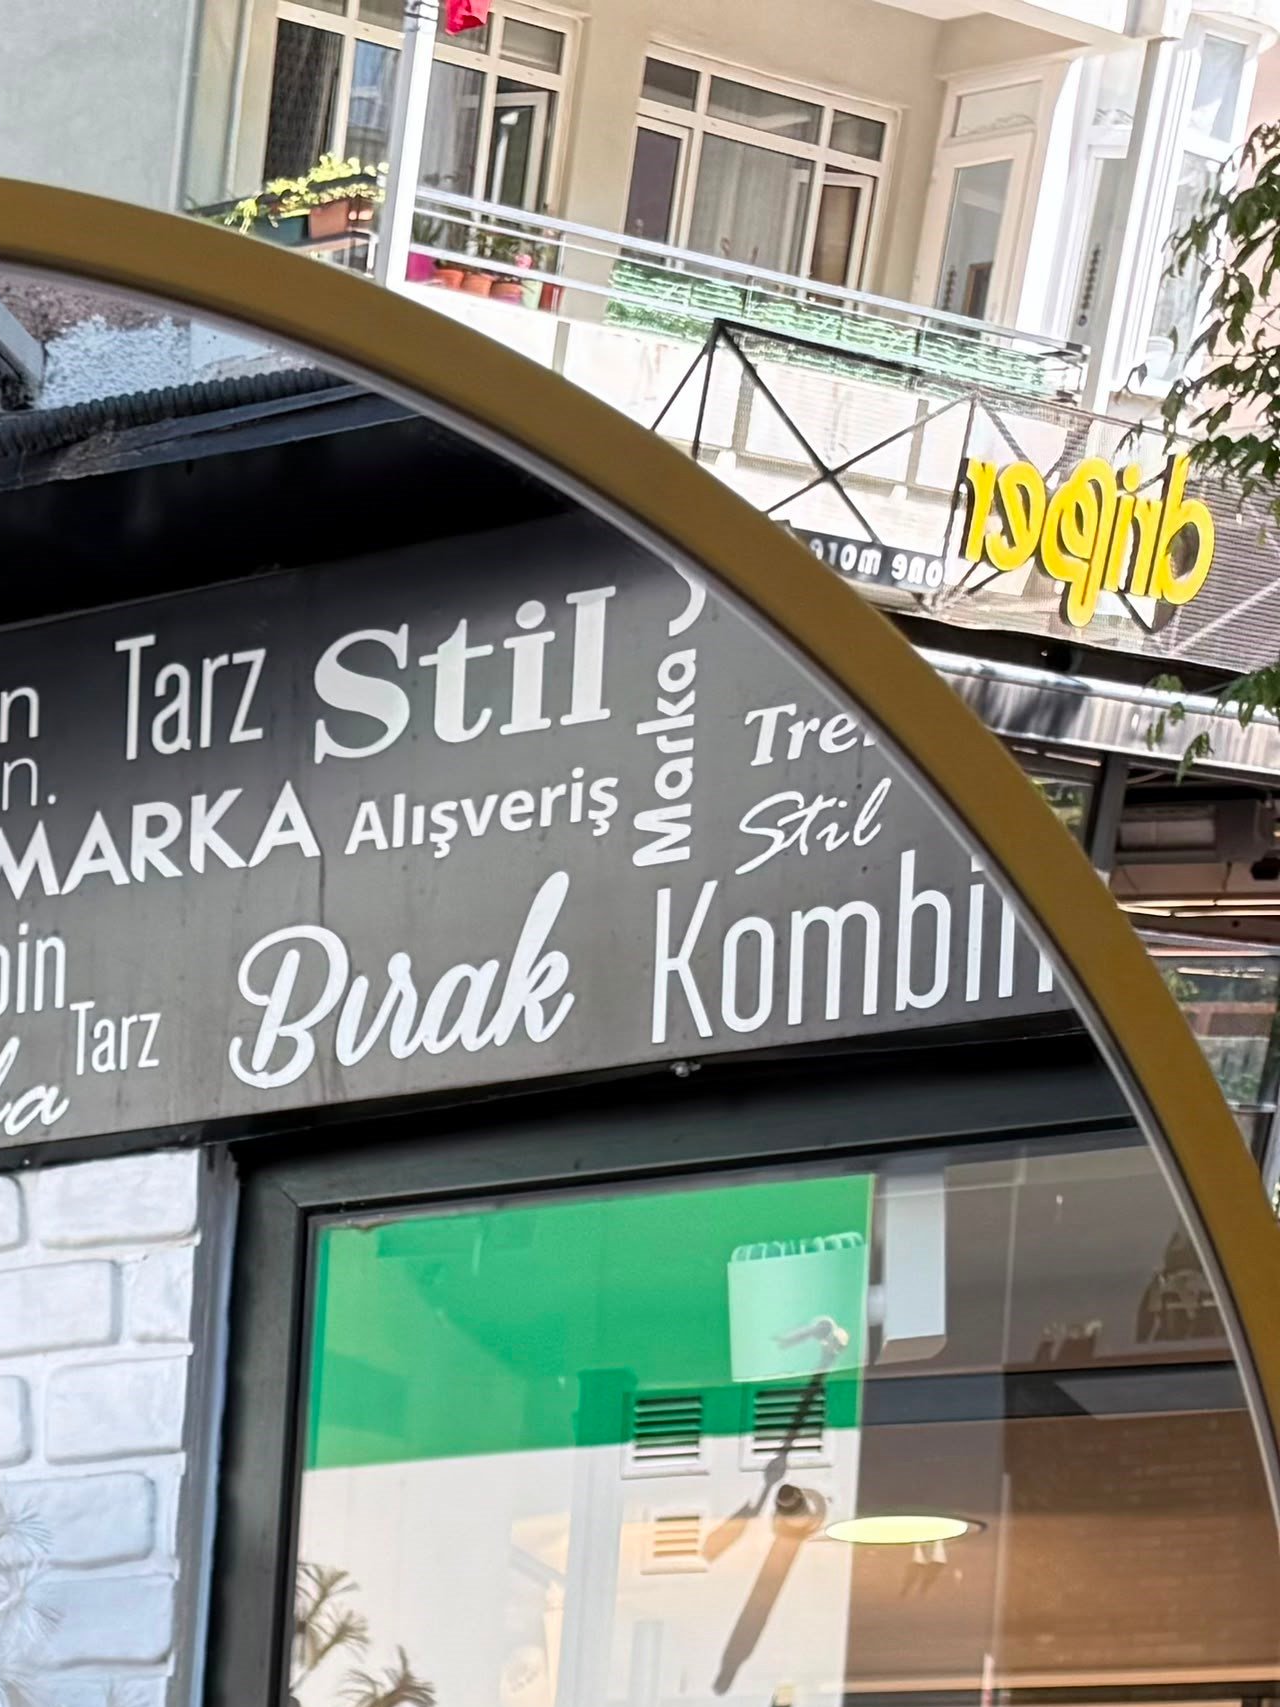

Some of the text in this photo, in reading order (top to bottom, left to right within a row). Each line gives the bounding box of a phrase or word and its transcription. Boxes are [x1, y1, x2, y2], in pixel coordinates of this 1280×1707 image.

[115, 633, 267, 760] Tarz
[315, 586, 615, 763] Stil
[344, 767, 619, 859] Alışveriş
[632, 649, 697, 867] Marka
[735, 778, 892, 875] Stil
[70, 1001, 162, 1076] Tarz
[229, 870, 575, 1089] Bırak
